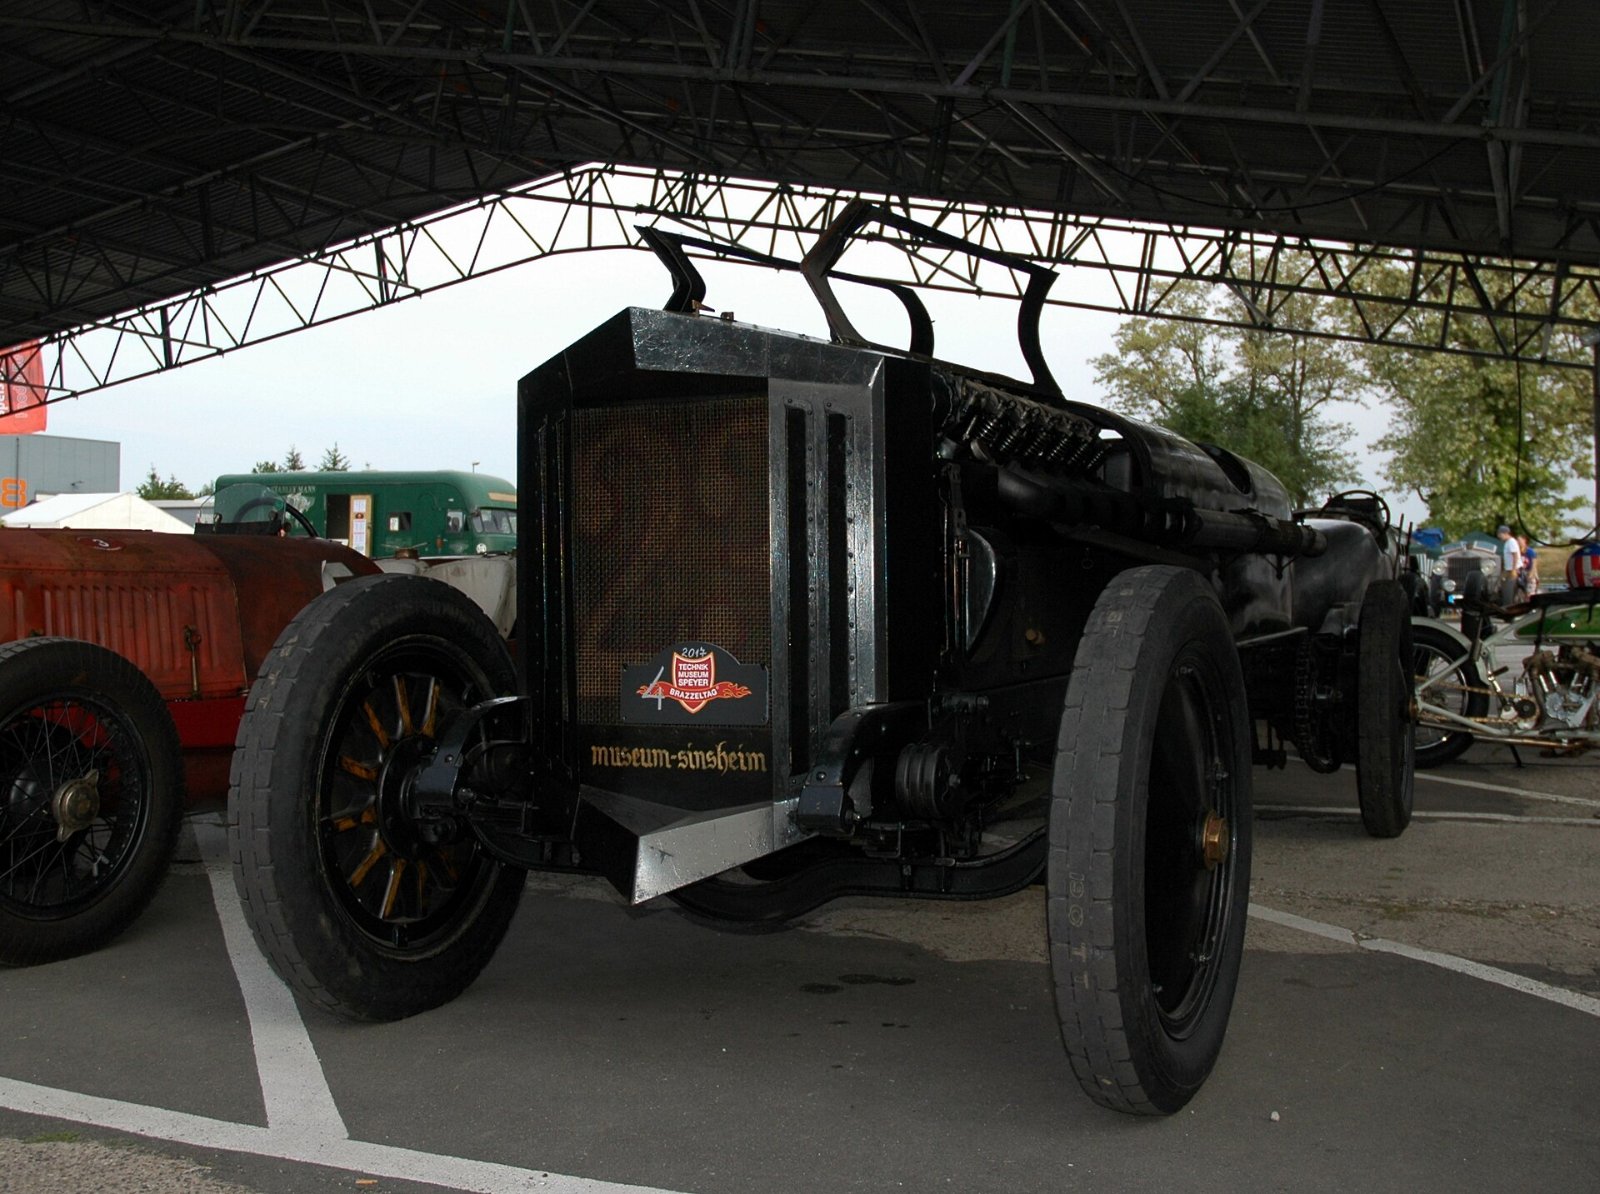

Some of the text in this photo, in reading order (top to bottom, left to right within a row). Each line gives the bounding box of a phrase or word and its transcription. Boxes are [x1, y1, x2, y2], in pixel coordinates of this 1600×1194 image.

[678, 663, 709, 671] TECHNIK
[641, 665, 666, 711] 4
[678, 678, 709, 687] SPEYER
[669, 687, 718, 700] BRAZZELTAG
[590, 741, 768, 776] museum-sinsheim
